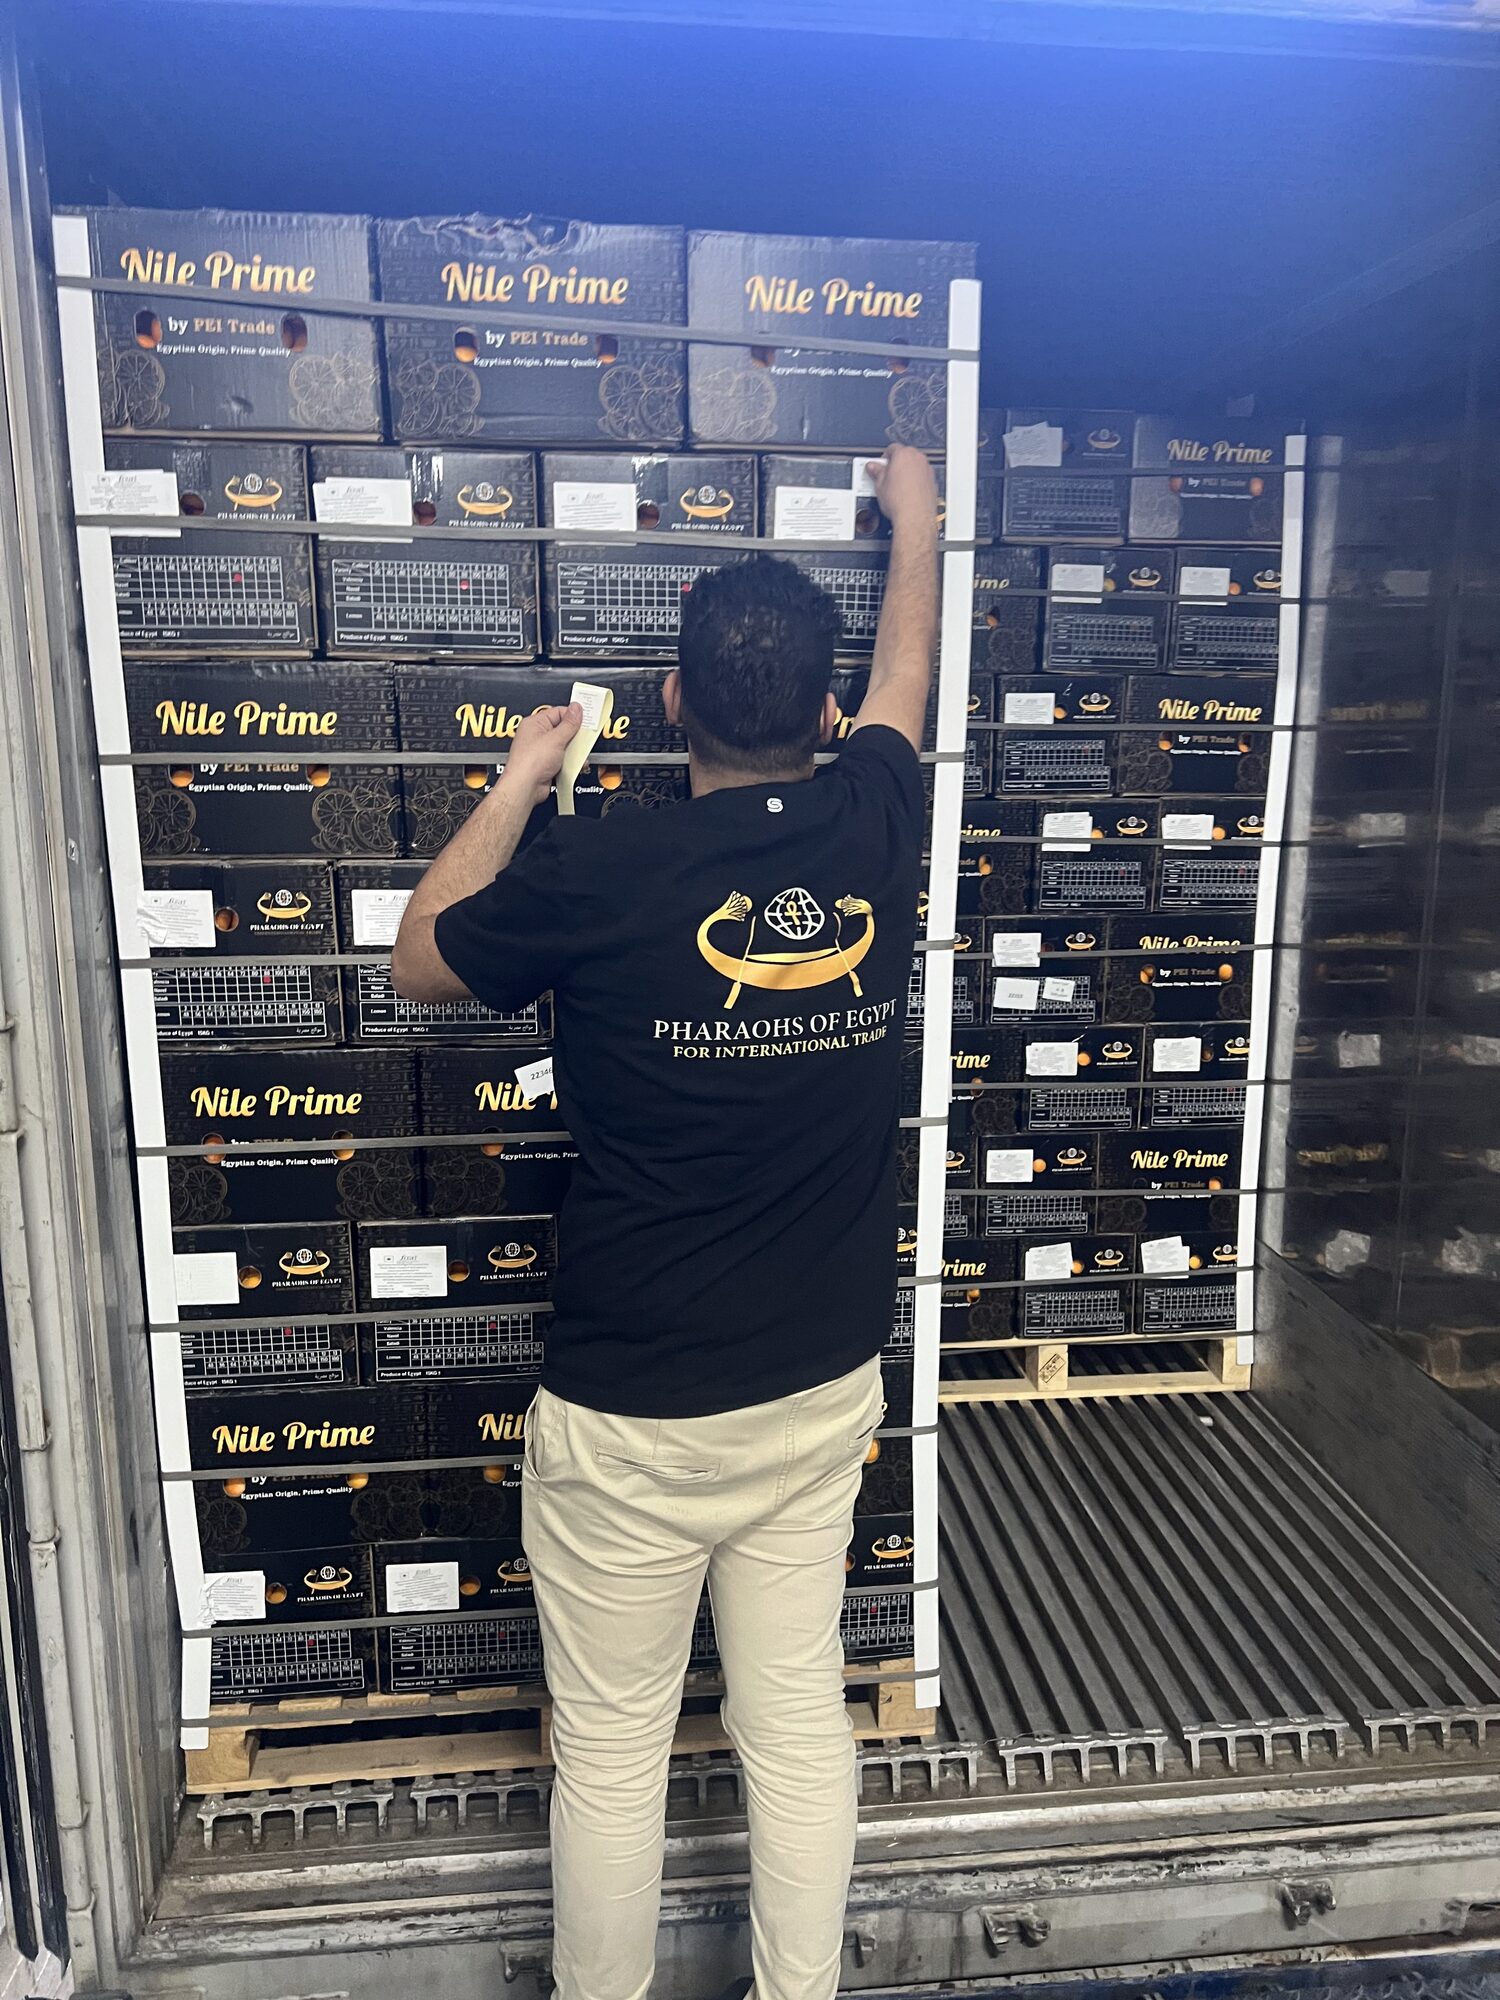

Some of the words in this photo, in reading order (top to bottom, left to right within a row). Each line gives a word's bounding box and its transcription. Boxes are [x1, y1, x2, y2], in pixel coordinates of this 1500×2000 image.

[120, 247, 196, 286] Nile
[205, 251, 315, 293] Prime
[441, 262, 514, 302] Nile
[522, 264, 628, 304] Prime
[746, 275, 814, 314] Nile
[822, 278, 922, 318] Prime
[167, 317, 188, 335] by
[193, 317, 222, 332] PEI
[228, 319, 275, 334] Trade
[485, 331, 504, 347] by
[510, 331, 536, 345] PEI
[543, 332, 588, 345] Trade
[157, 343, 195, 356] Egyptian
[198, 344, 229, 356] Origin,
[231, 345, 257, 355] Prime
[259, 346, 291, 358] Quality
[474, 357, 511, 367] Egyptian
[513, 357, 542, 367] Origin,
[545, 358, 569, 366] Prime
[571, 358, 602, 369] Quality
[1167, 439, 1209, 461] Nile
[1212, 441, 1272, 463] Prime
[973, 573, 1009, 589] ime
[155, 700, 226, 736] Nile
[234, 700, 338, 736] Prime
[1158, 698, 1200, 720] Nile
[1203, 700, 1262, 721] Prime
[455, 703, 521, 739] Nile
[1178, 734, 1191, 744] by
[200, 763, 218, 775] by
[188, 784, 225, 793] Egyptian
[227, 784, 256, 793] Origin,
[257, 783, 282, 792] Prime
[283, 783, 314, 793] Quality
[575, 786, 604, 795] Quality
[301, 923, 324, 931] EGYPT
[1160, 968, 1172, 978] by
[653, 1016, 804, 1041] PHARAOHS
[810, 1012, 840, 1033] OF
[846, 998, 897, 1029] EGYPT
[673, 1045, 710, 1059] FOR
[715, 1035, 850, 1058] INTERNATIONAL
[853, 1025, 888, 1047] TRADE
[950, 1050, 991, 1069] rime
[190, 1086, 257, 1117] Nile
[264, 1085, 362, 1117] Prime
[475, 1081, 537, 1111] Nile
[221, 1160, 255, 1168] Egyptian
[257, 1158, 284, 1167] Origin,
[286, 1158, 309, 1166] Prime
[310, 1158, 339, 1166] Quality
[535, 1152, 561, 1160] Origin,
[1130, 1150, 1170, 1169] Nile
[1173, 1149, 1229, 1168] Prime
[1151, 1181, 1163, 1190] by
[272, 1280, 309, 1288] PHARAOHS
[478, 1412, 525, 1441] Nil
[212, 1424, 275, 1454] Nile
[283, 1421, 375, 1450] Prime
[241, 1491, 274, 1500] Egyptian
[275, 1490, 301, 1498] Origin,
[302, 1488, 325, 1496] Prime
[326, 1486, 354, 1495] Quality
[297, 1595, 332, 1603] PHARAOHS
